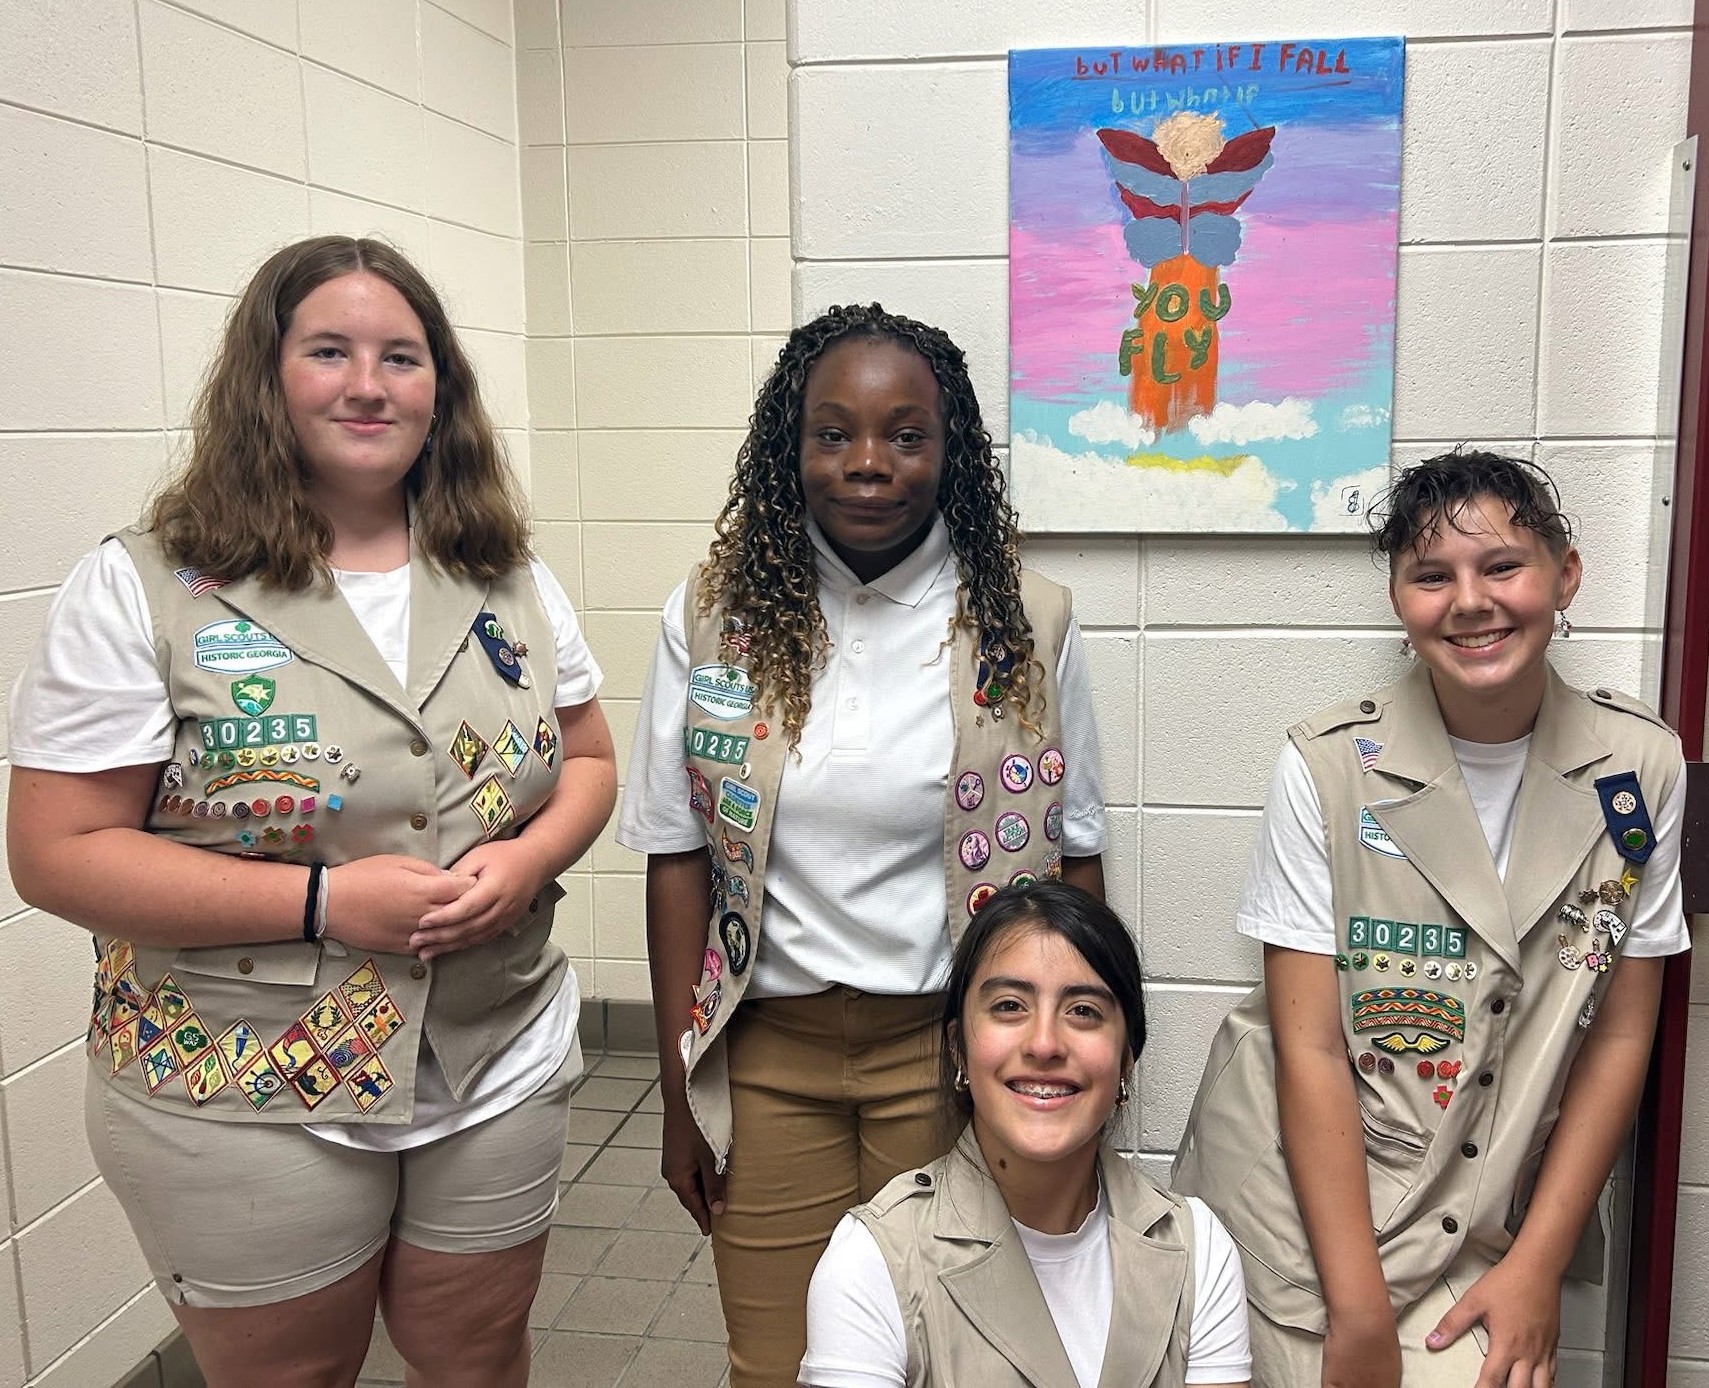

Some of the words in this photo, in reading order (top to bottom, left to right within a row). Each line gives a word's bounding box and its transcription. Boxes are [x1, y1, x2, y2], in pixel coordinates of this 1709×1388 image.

[1248, 43, 1266, 71] I
[1278, 43, 1350, 76] FALL
[1131, 282, 1232, 323] YOU
[1119, 325, 1213, 384] FLY
[198, 635, 221, 644] GIRL
[223, 632, 267, 643] SCOUTS
[201, 651, 245, 662] HISTORIC
[246, 649, 288, 659] GEORGIA
[694, 673, 713, 684] GIRL
[714, 678, 745, 692] SCOUTS
[694, 692, 726, 706] HISTORIC
[202, 717, 311, 748] 30235
[693, 731, 747, 760] 0235
[1364, 831, 1391, 842] HISTO
[1352, 920, 1462, 953] 30235
[184, 1031, 199, 1041] GS
